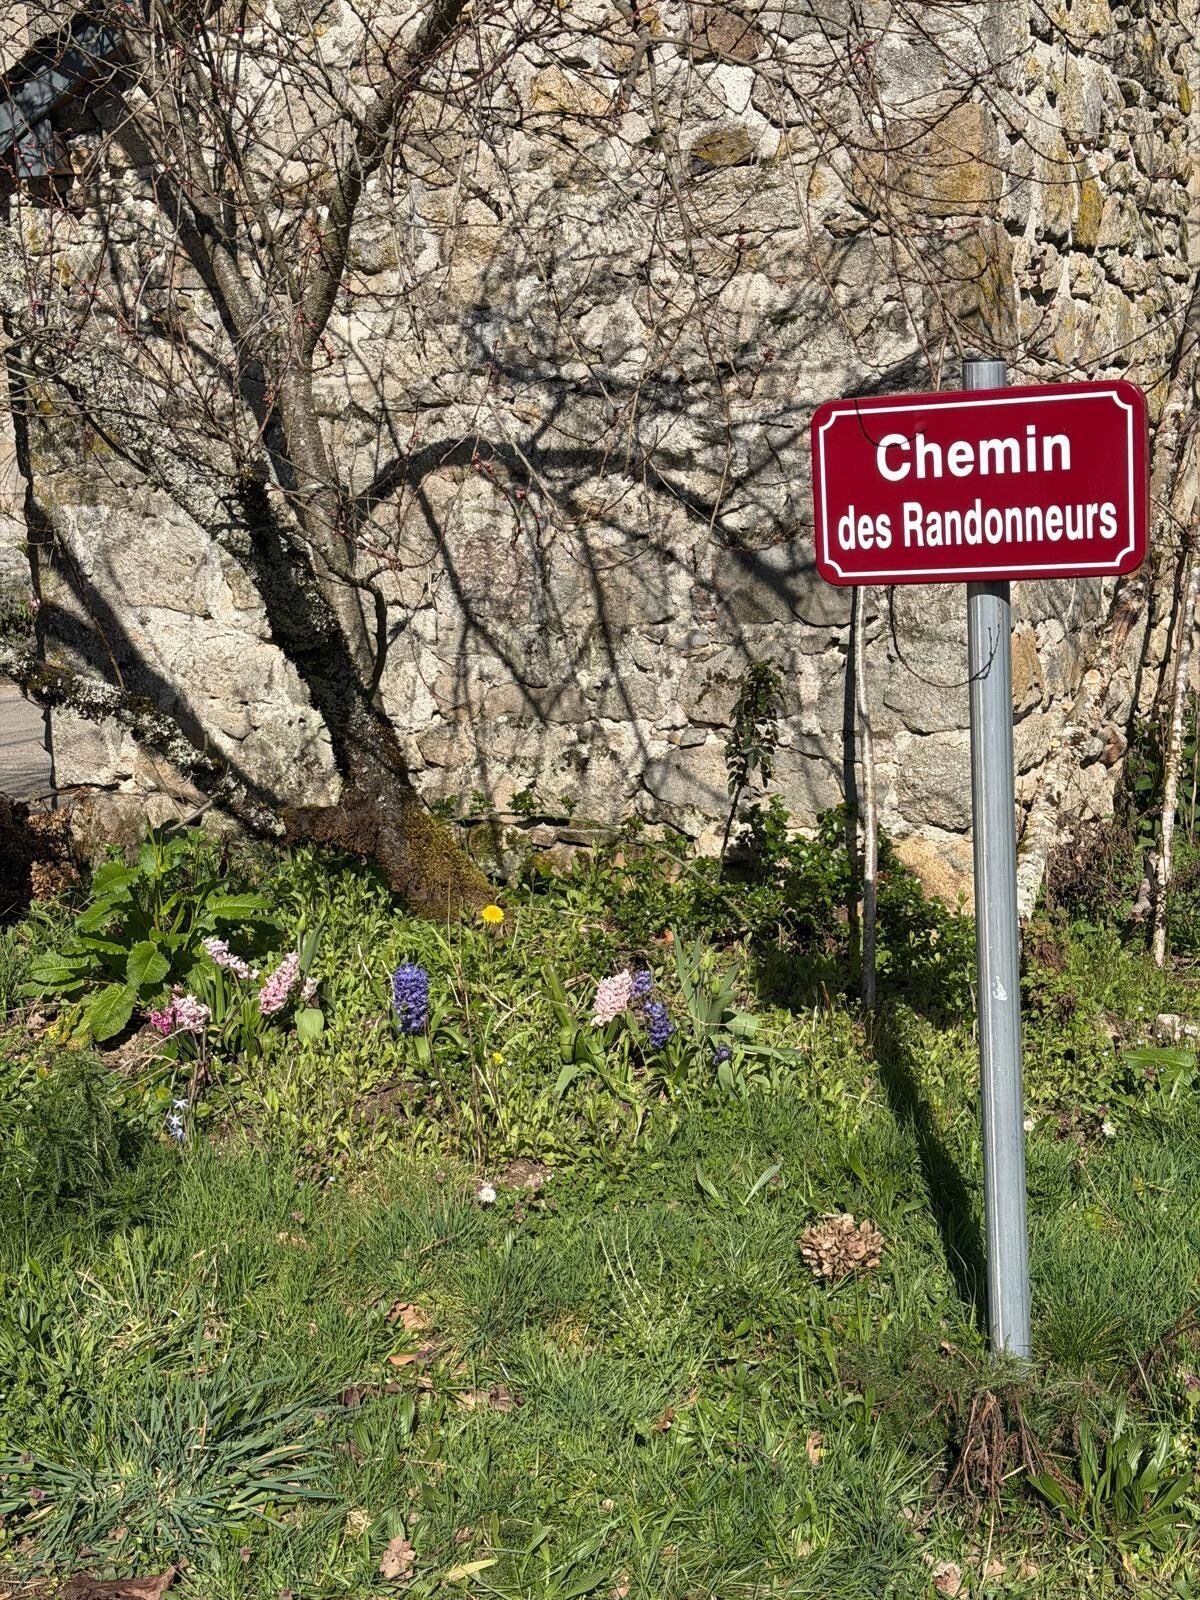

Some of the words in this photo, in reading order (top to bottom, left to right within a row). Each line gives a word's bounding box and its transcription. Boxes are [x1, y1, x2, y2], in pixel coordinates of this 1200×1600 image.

[876, 424, 1072, 482] Chemin
[837, 505, 892, 551] des
[902, 498, 1118, 547] Randonneurs
